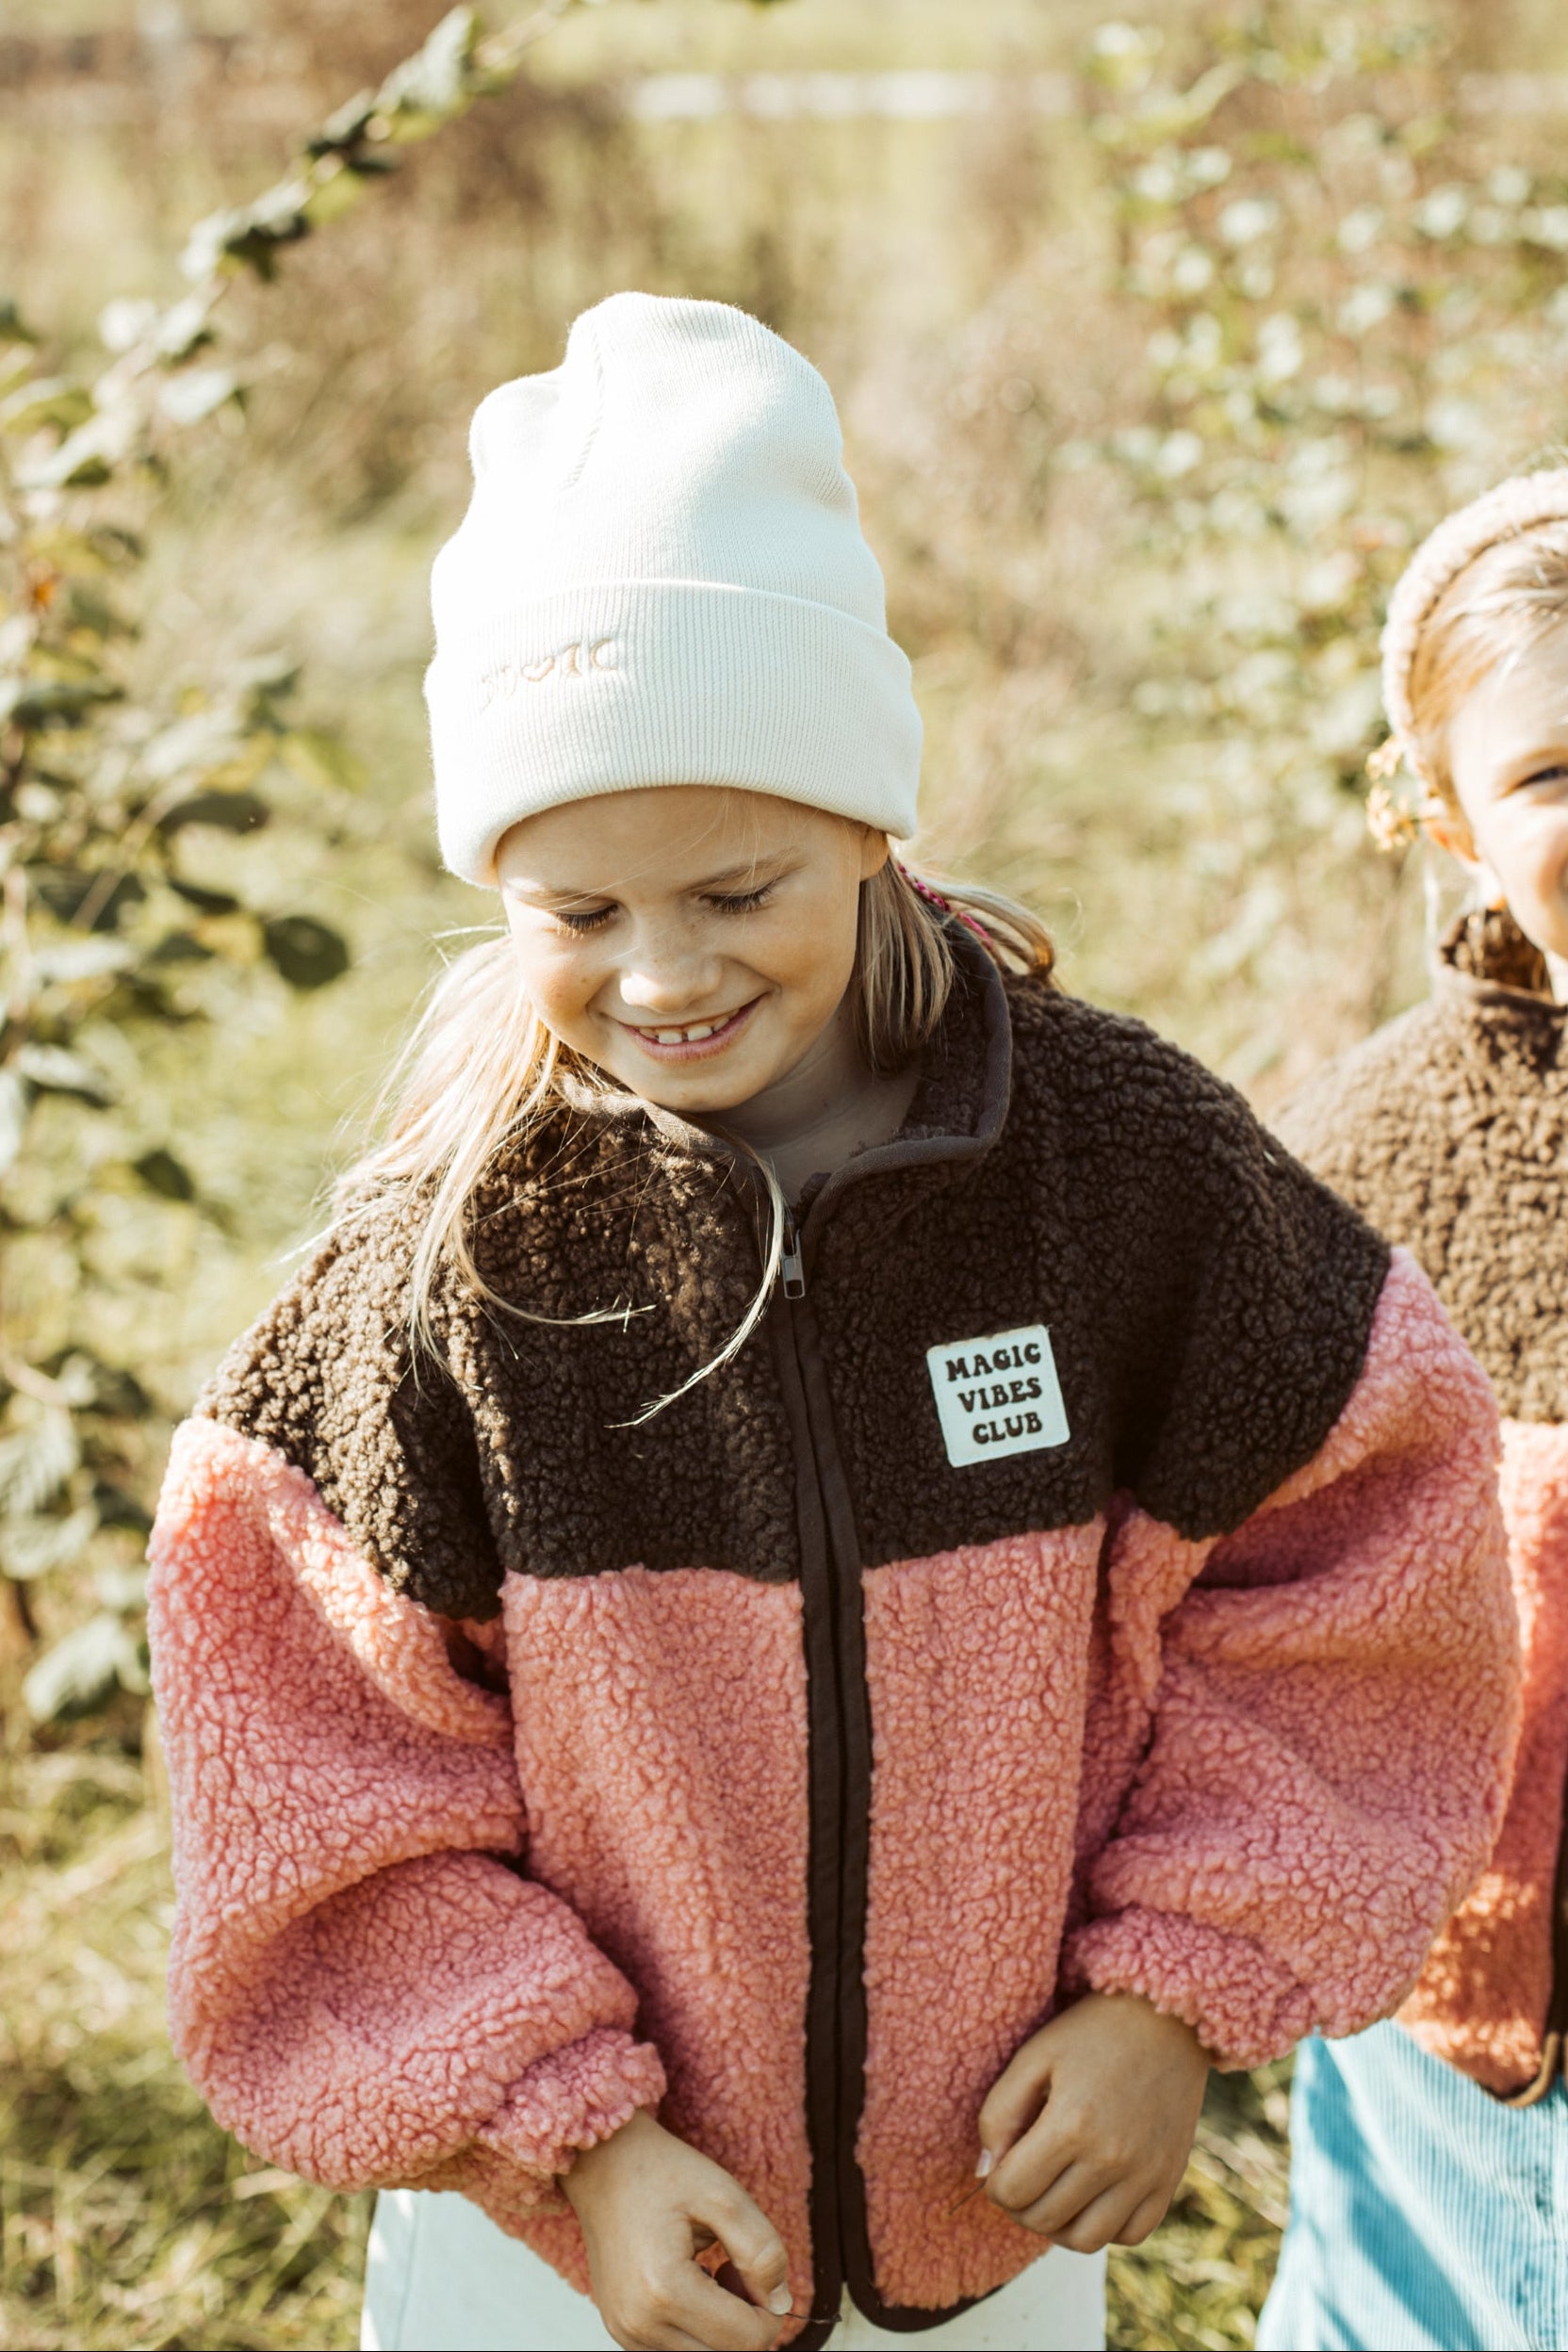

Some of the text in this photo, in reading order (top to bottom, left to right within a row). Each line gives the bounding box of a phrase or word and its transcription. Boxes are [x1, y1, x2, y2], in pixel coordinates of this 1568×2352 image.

[945, 1343, 1041, 1381] MAGIC
[957, 1377, 1042, 1413] VIBES
[972, 1412, 1043, 1445] CLUB
